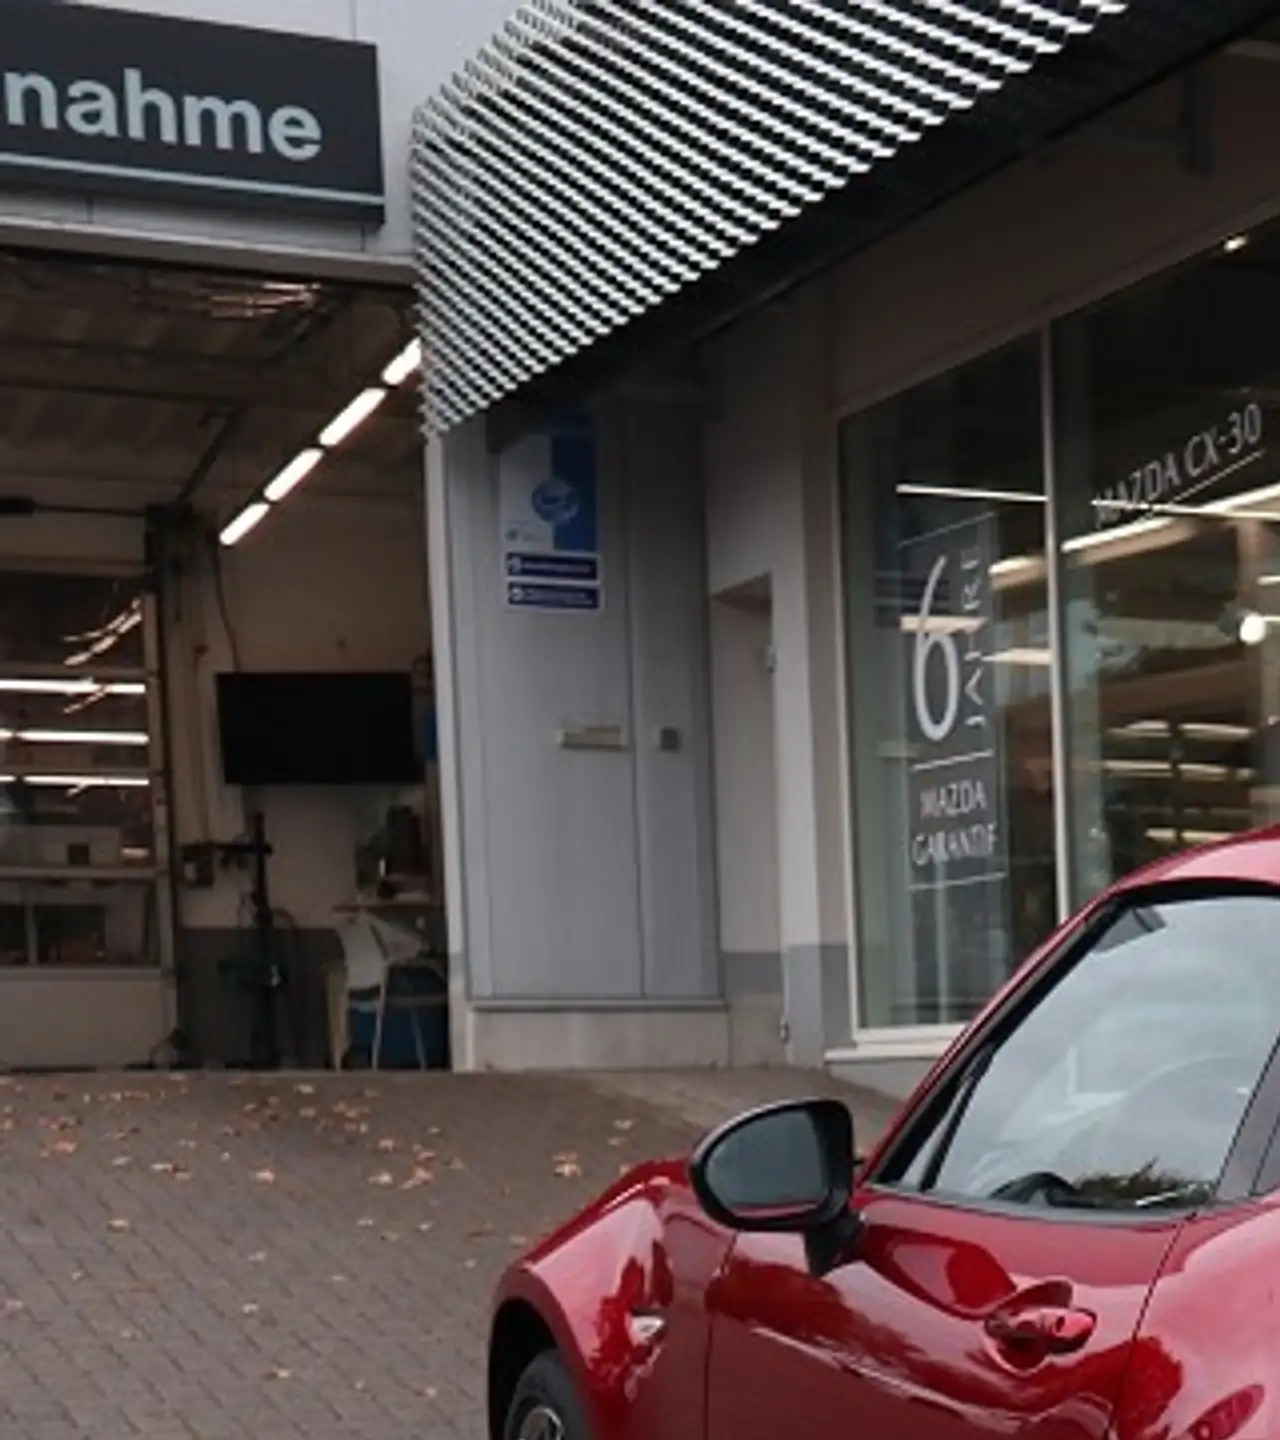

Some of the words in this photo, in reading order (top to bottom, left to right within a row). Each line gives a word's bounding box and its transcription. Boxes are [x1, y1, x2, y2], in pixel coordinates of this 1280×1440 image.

[4, 67, 322, 163] nahme
[1184, 404, 1262, 477] CX-30
[913, 555, 960, 742] 6
[920, 780, 986, 818] MAZDA
